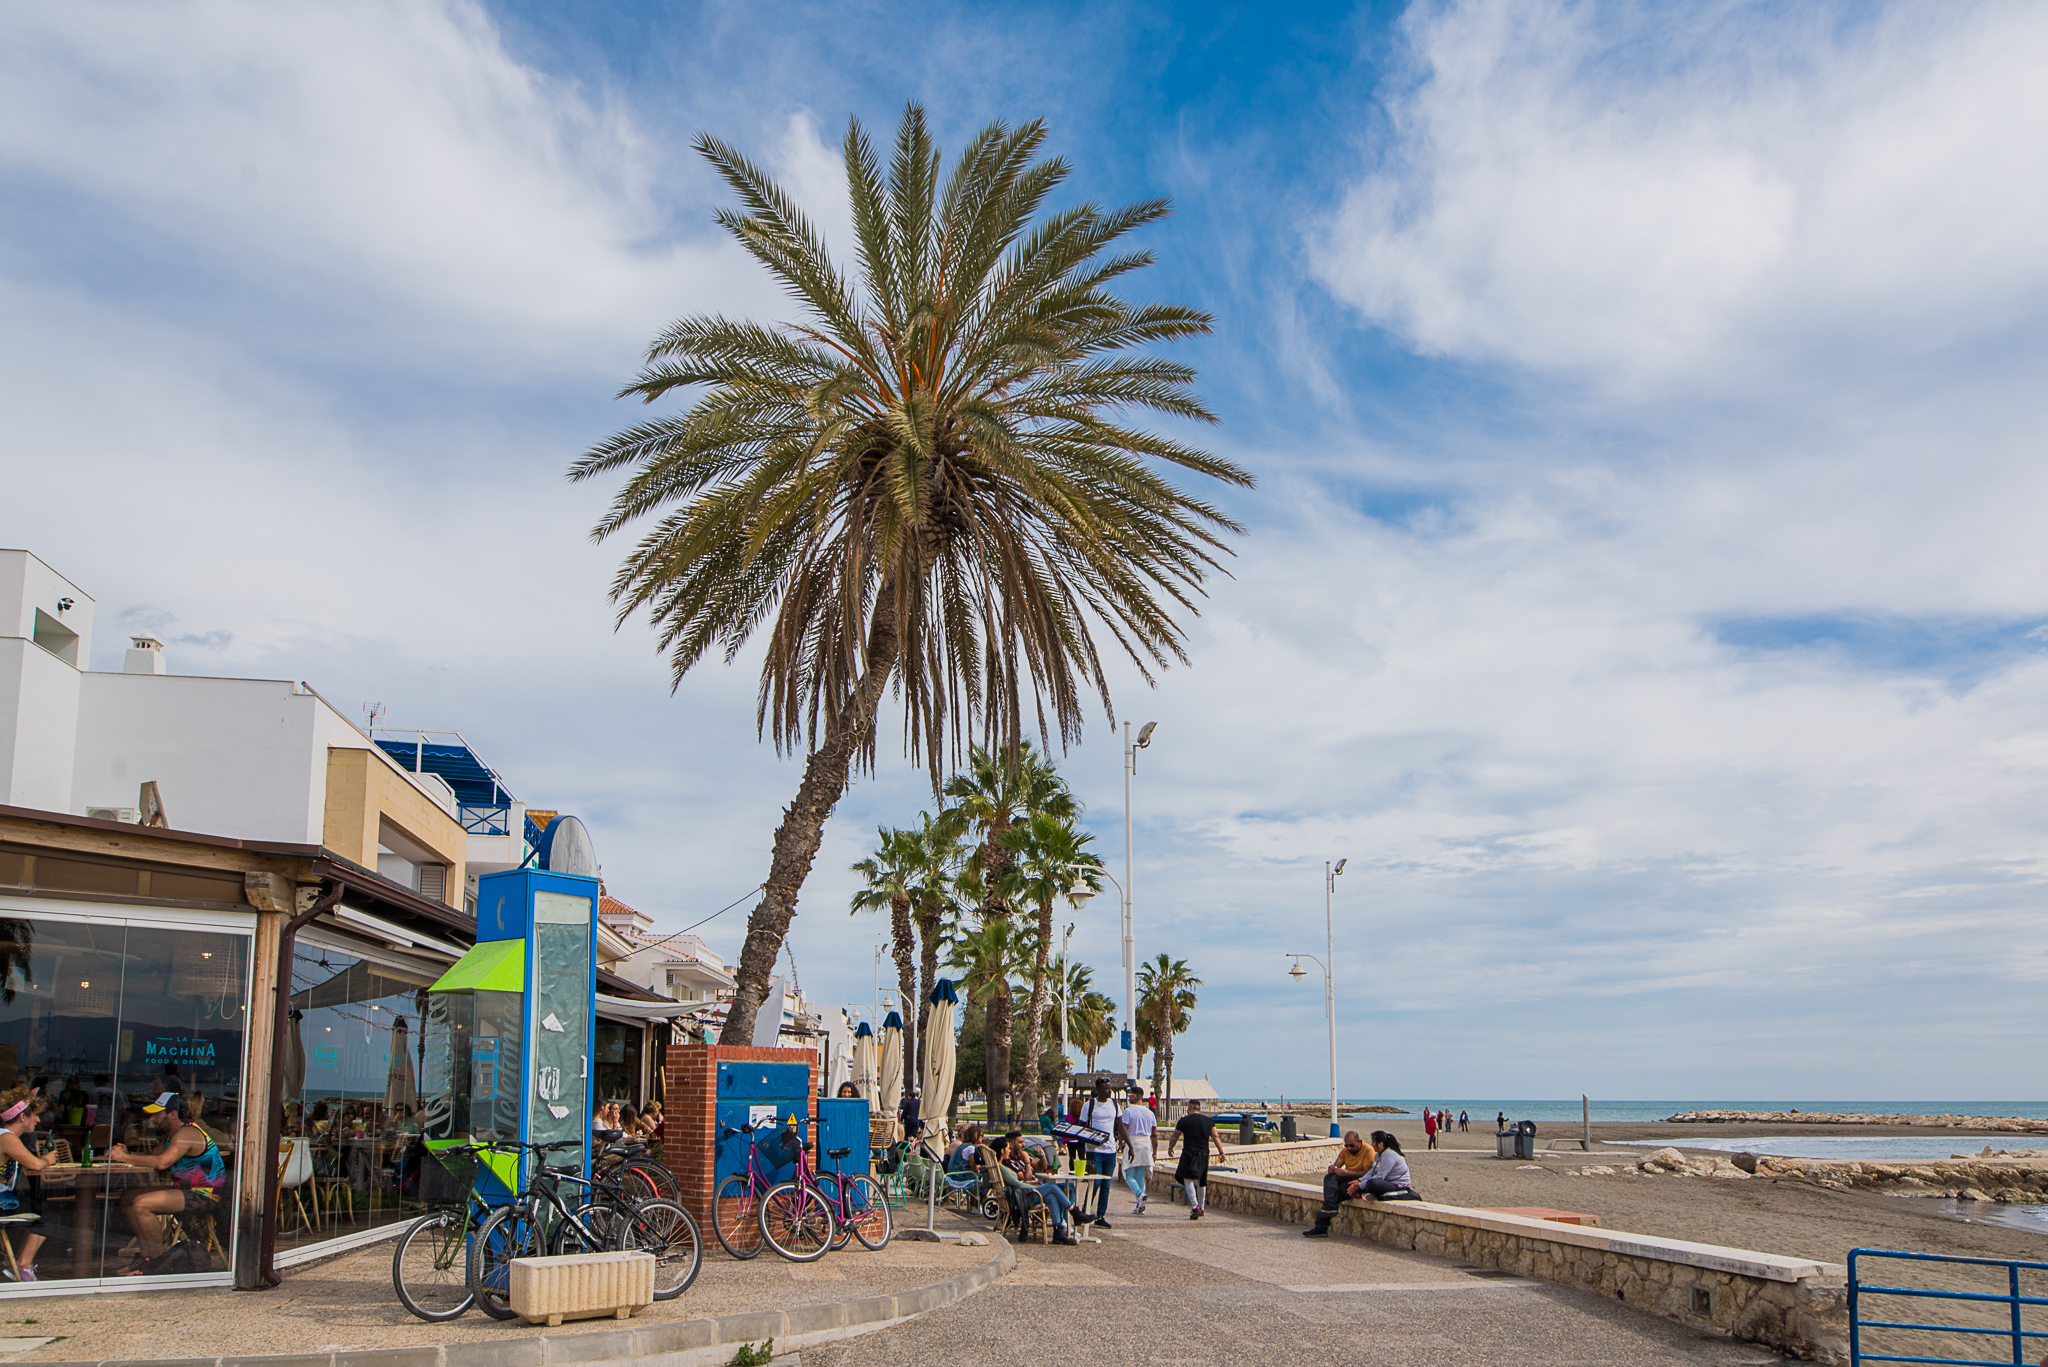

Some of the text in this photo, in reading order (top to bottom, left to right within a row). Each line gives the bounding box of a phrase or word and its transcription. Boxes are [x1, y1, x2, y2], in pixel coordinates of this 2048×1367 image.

[146, 1040, 216, 1057] MACHINA
[145, 1057, 170, 1065] FOOD
[182, 1058, 216, 1066] DRINKS
